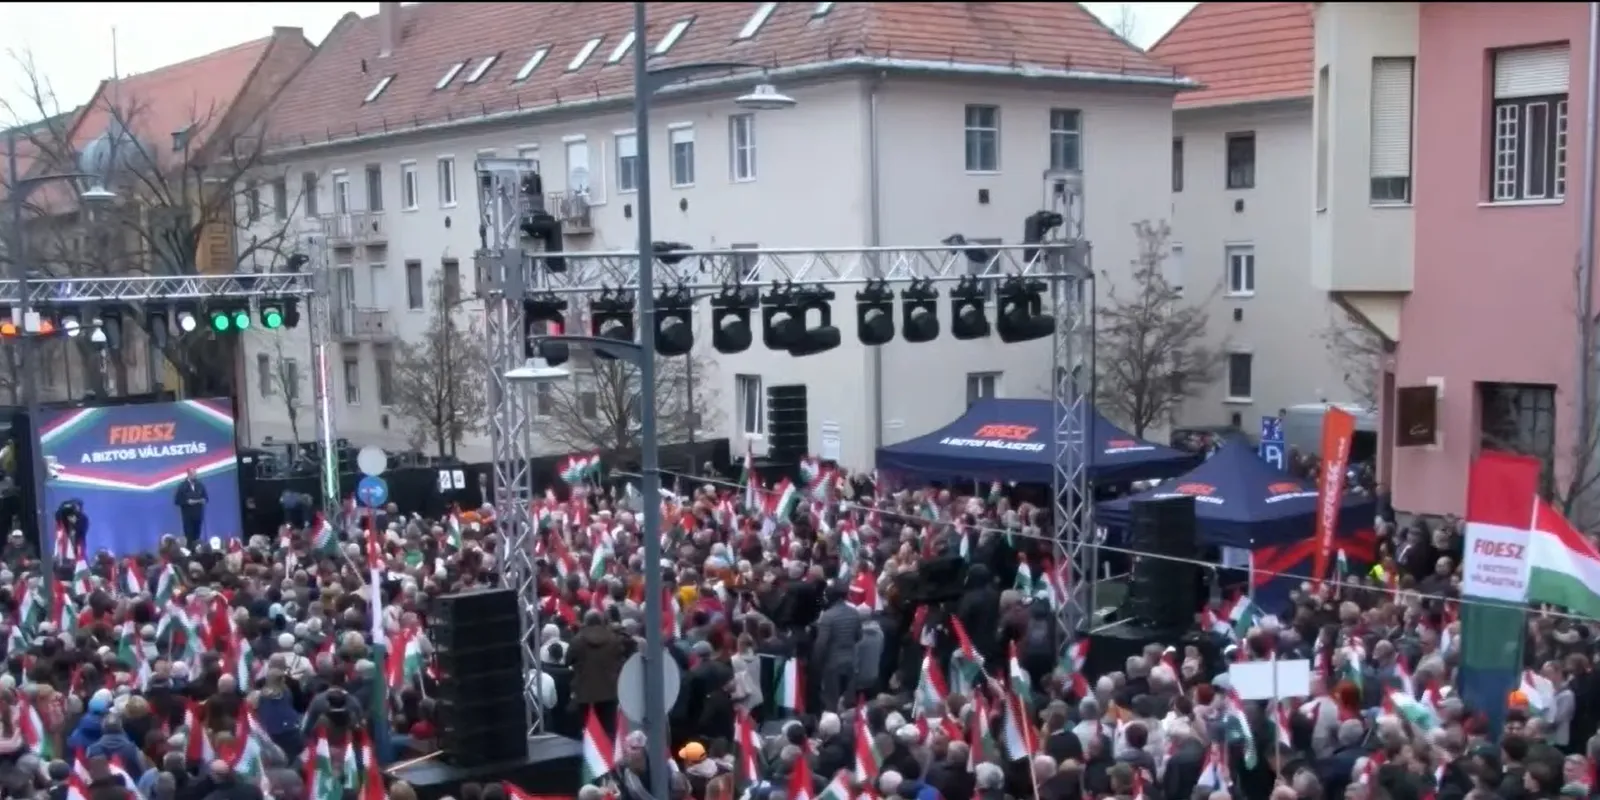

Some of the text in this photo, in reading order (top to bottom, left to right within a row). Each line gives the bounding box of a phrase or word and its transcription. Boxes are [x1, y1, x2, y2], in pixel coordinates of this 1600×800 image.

[109, 422, 176, 445] FIDESZ
[81, 441, 207, 464] A BIZTOS VÁLASZTÁS
[1473, 537, 1526, 560] FIDESZ
